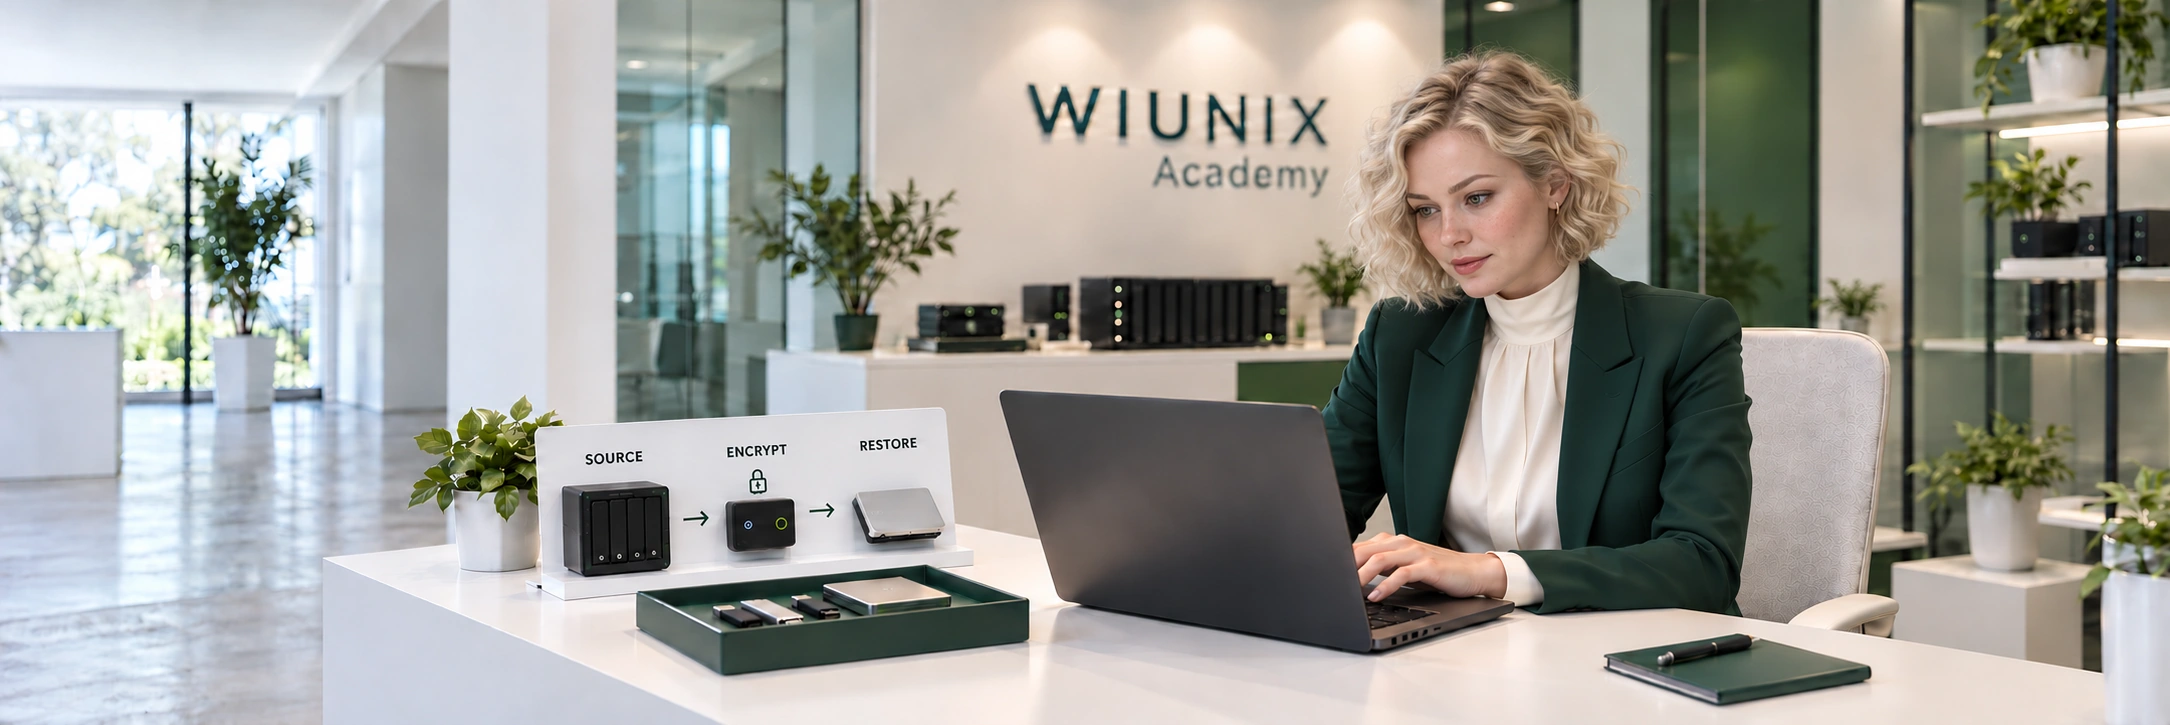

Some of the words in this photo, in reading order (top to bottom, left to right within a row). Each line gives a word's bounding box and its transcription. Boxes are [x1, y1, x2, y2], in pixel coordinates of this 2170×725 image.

[1026, 83, 1328, 146] WIUNIX
[1152, 155, 1329, 198] Academy
[726, 443, 788, 459] ENCRYPT
[859, 437, 918, 452] RESTORE
[584, 450, 644, 466] SOURCE
